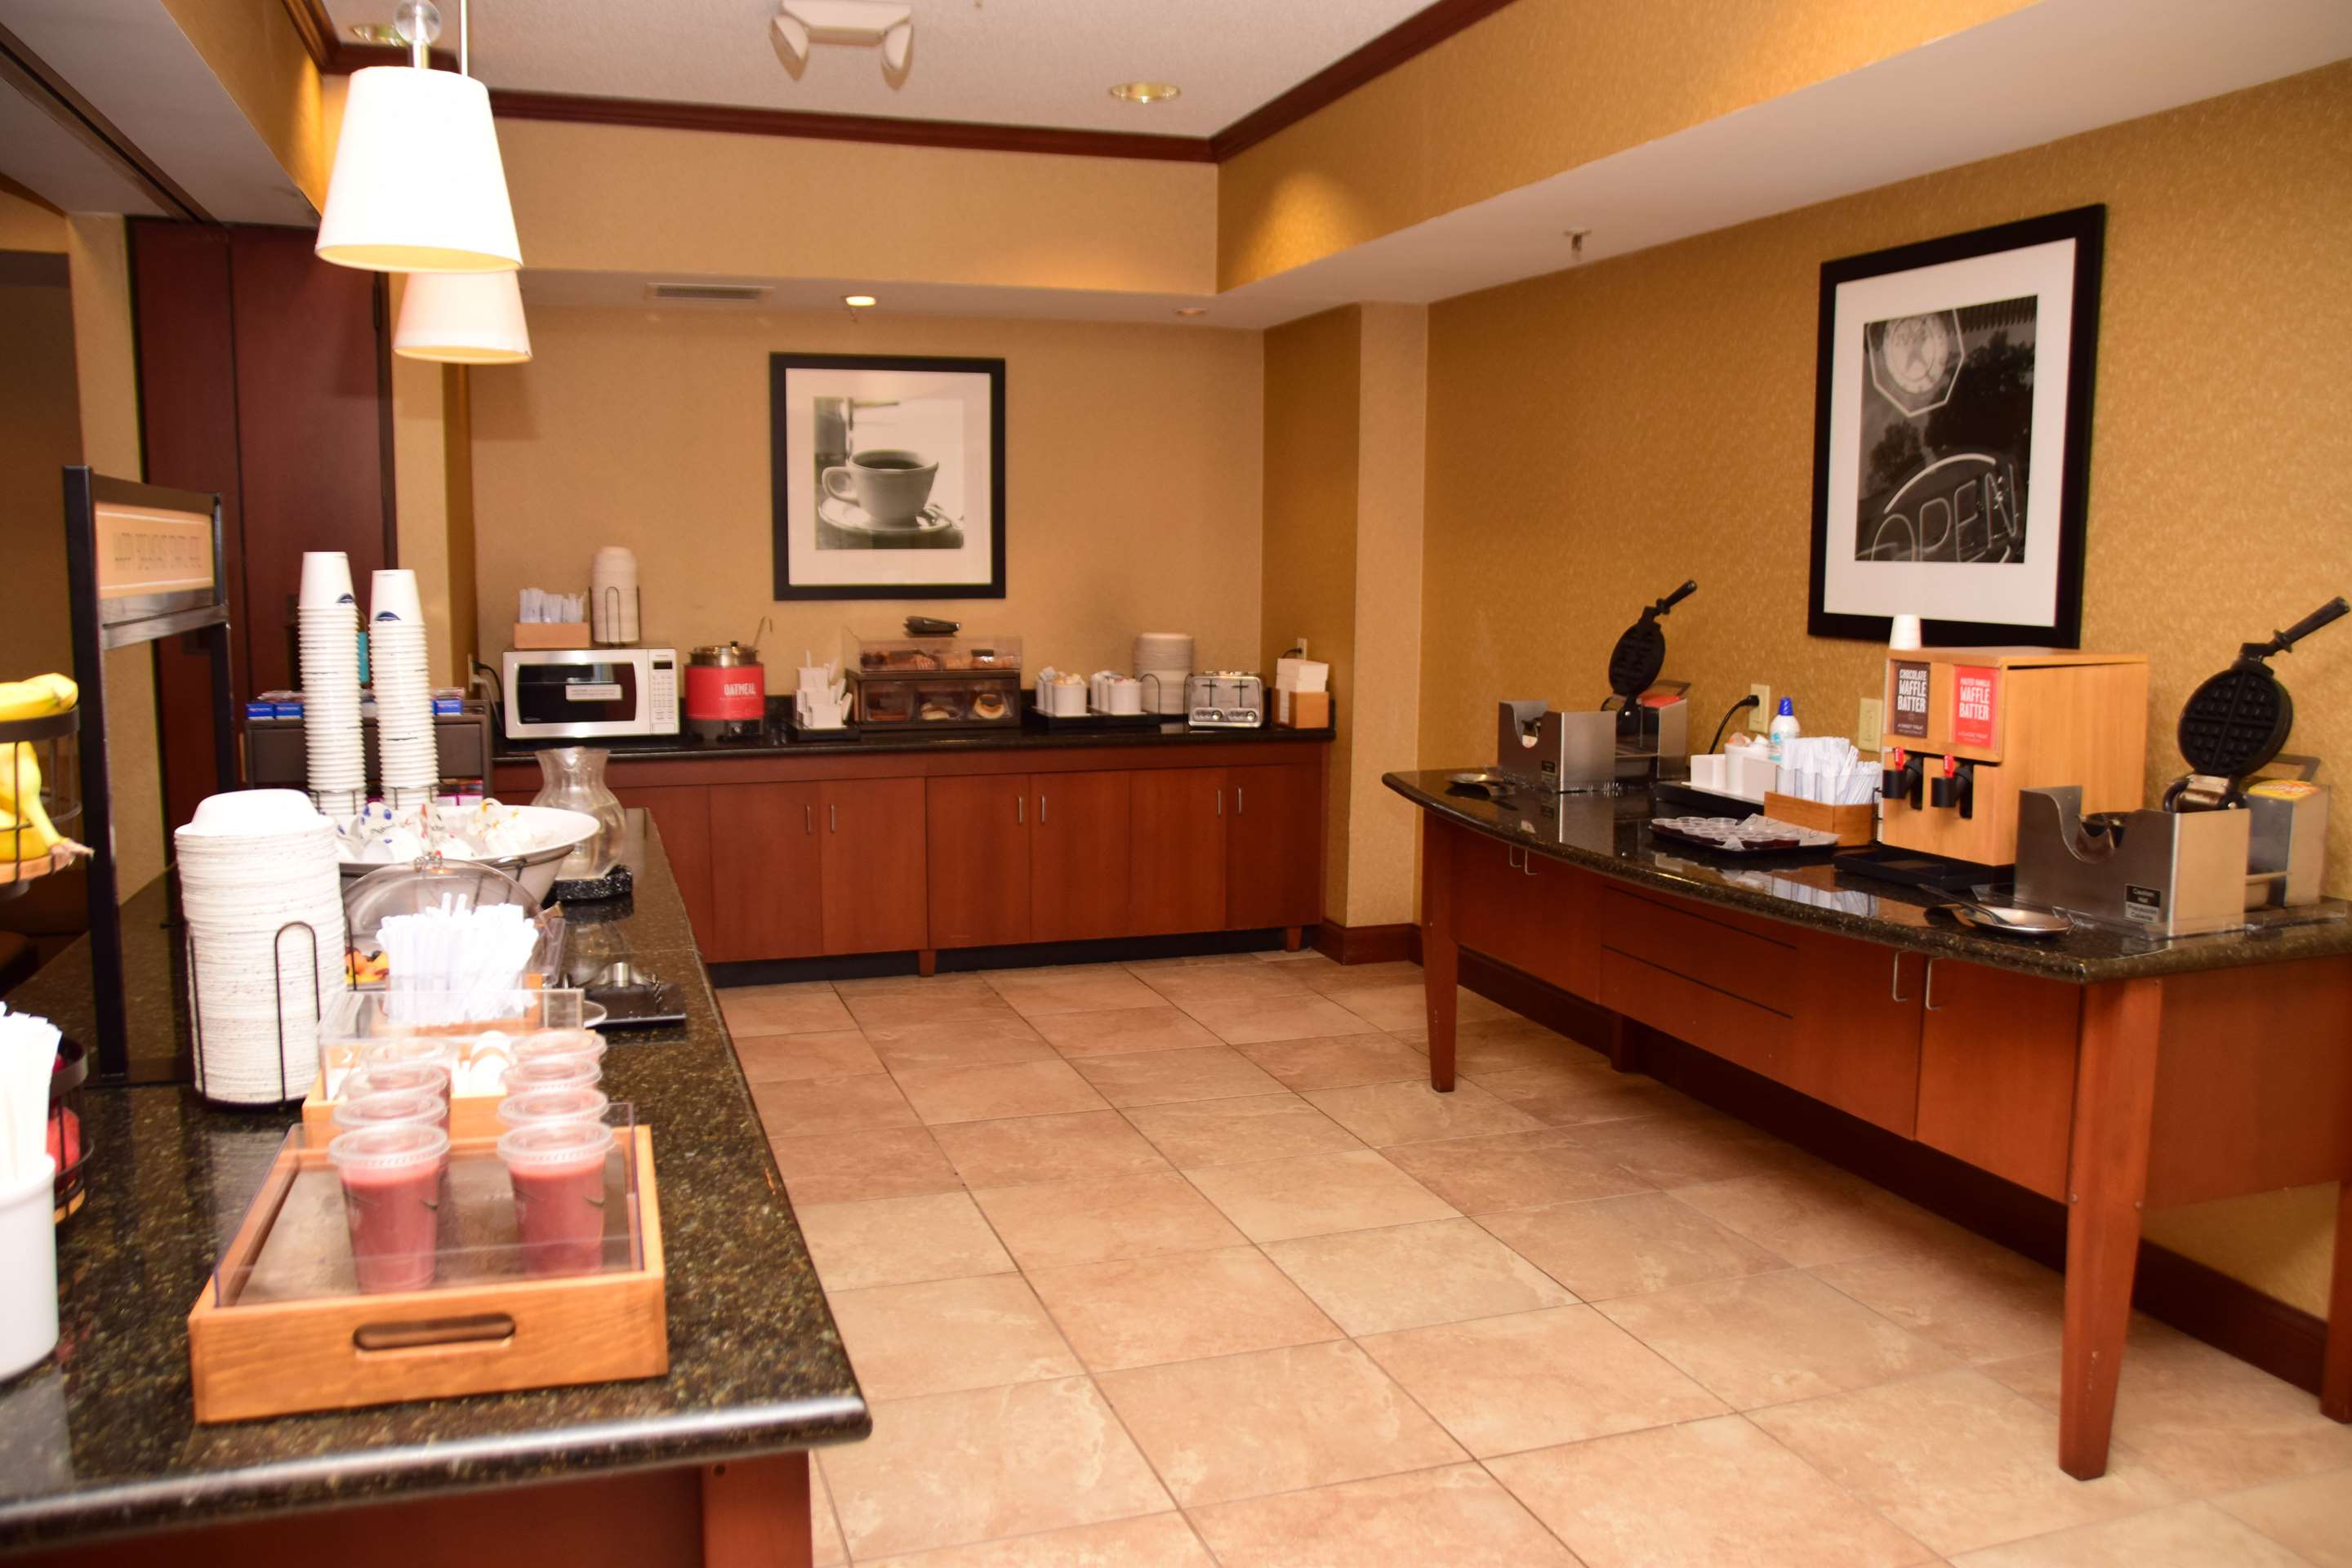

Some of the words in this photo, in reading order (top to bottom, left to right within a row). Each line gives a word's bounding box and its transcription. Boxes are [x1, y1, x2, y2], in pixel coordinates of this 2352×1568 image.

[1870, 463, 2017, 563] OPEN
[1899, 669, 1927, 680] CHOCOLATE
[724, 683, 756, 696] OATMEAL
[1899, 679, 1927, 697] WAFFLE
[1960, 685, 1990, 704] WAFFLE
[1897, 695, 1927, 713] BATTER
[1958, 702, 1989, 720] BATTER
